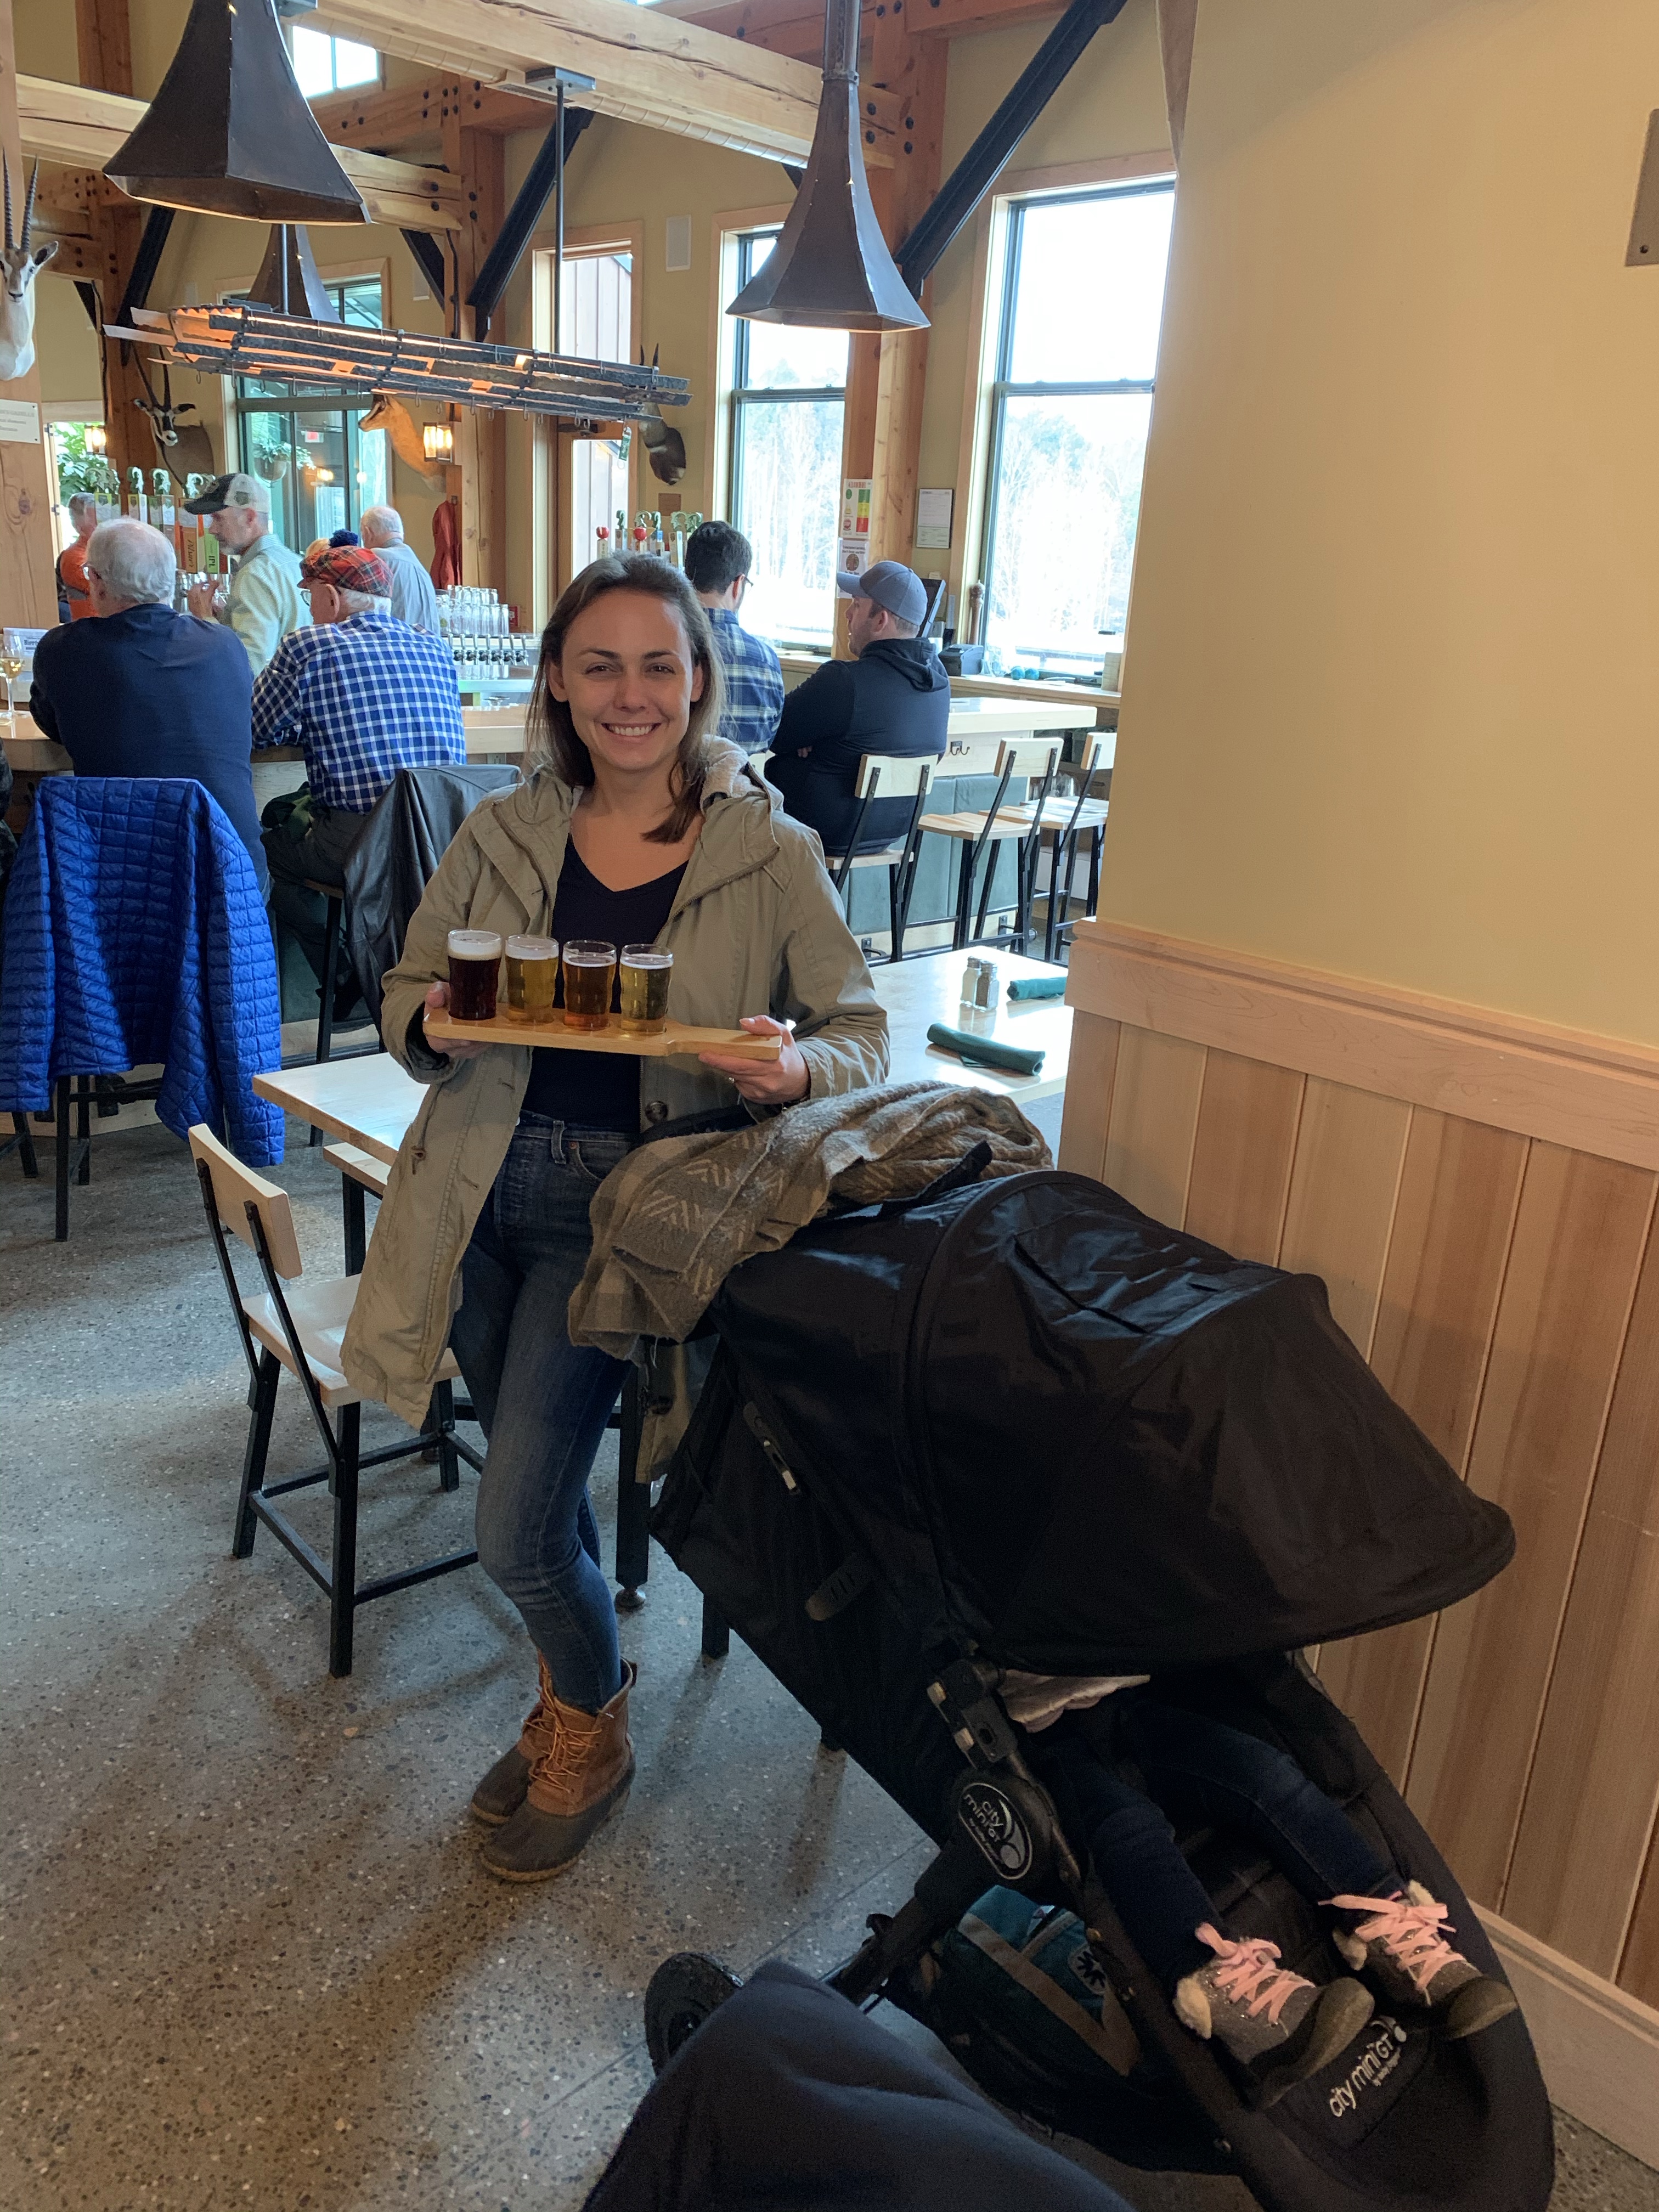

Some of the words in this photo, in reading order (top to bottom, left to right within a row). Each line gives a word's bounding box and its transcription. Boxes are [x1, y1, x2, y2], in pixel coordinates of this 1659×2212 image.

[964, 1794, 991, 1828] mini
[981, 1801, 1003, 1827] city
[1329, 2079, 1356, 2118] city
[1351, 2044, 1381, 2091] mini
[1376, 2033, 1393, 2058] GT
